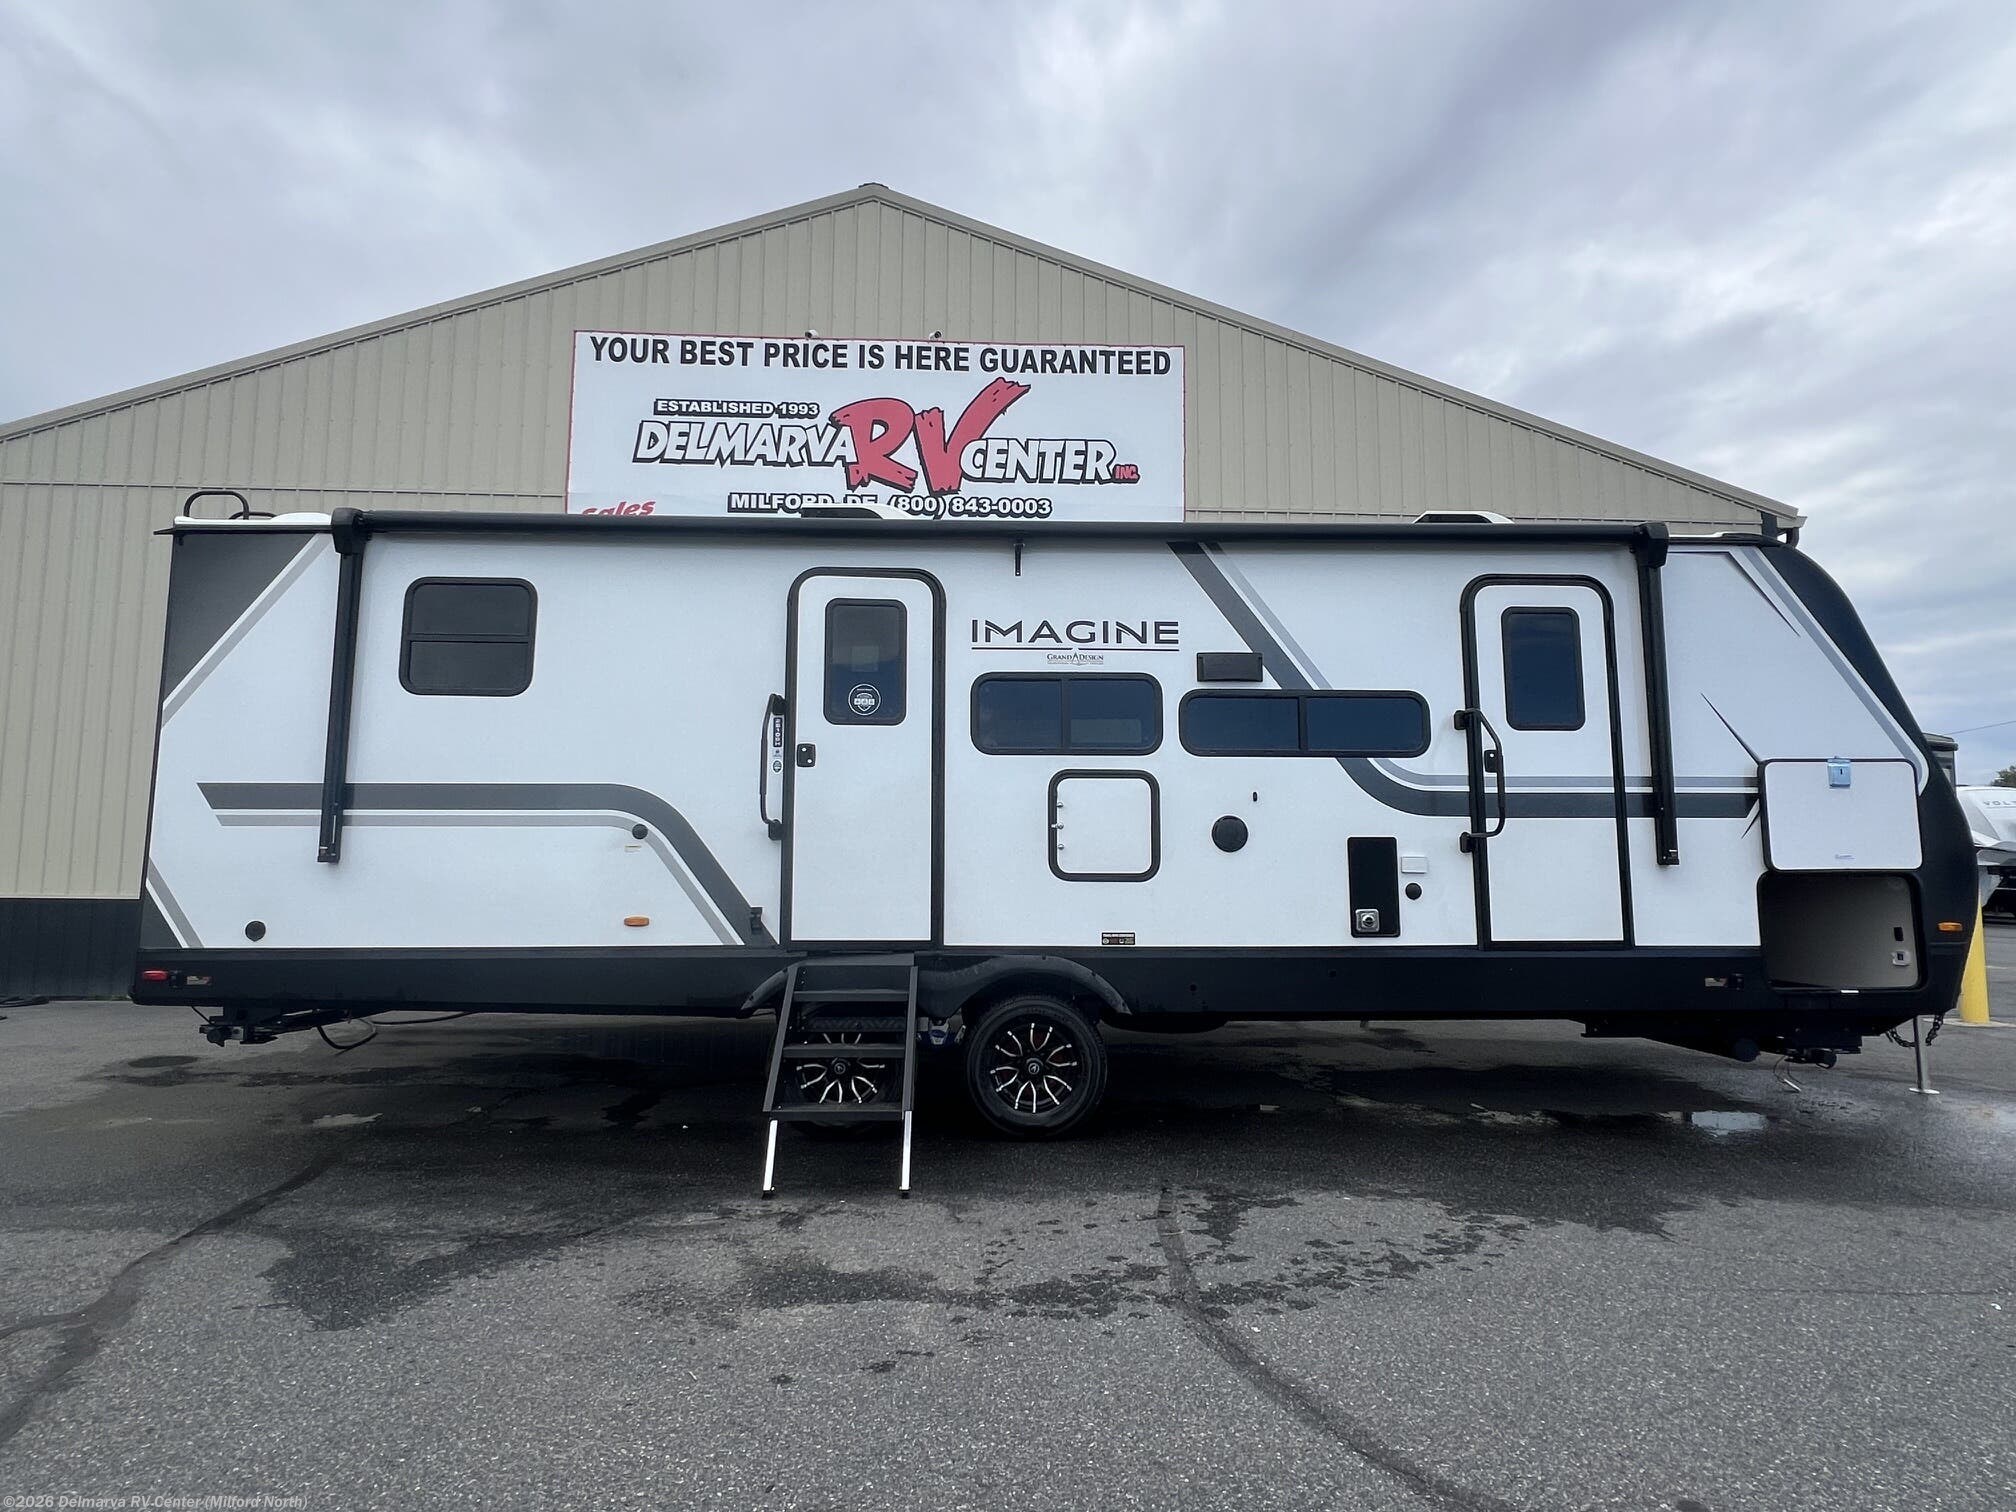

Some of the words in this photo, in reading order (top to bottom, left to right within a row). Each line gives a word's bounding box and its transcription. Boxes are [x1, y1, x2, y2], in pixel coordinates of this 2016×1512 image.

[590, 336, 670, 364] YOUR
[680, 339, 754, 367] BEST
[764, 342, 848, 369] PRICE
[858, 344, 885, 370] IS
[895, 345, 970, 372] HERE
[979, 347, 1171, 375] GUARANTEED
[656, 399, 775, 416] ESTABLISHED
[777, 401, 819, 416] 1993
[632, 420, 859, 467] DELMARVA
[828, 377, 1031, 495] RV
[960, 438, 1117, 484] CENTER
[889, 495, 945, 516] (800)
[950, 498, 1052, 516] 843-0003
[971, 619, 1180, 645] IMAGINE
